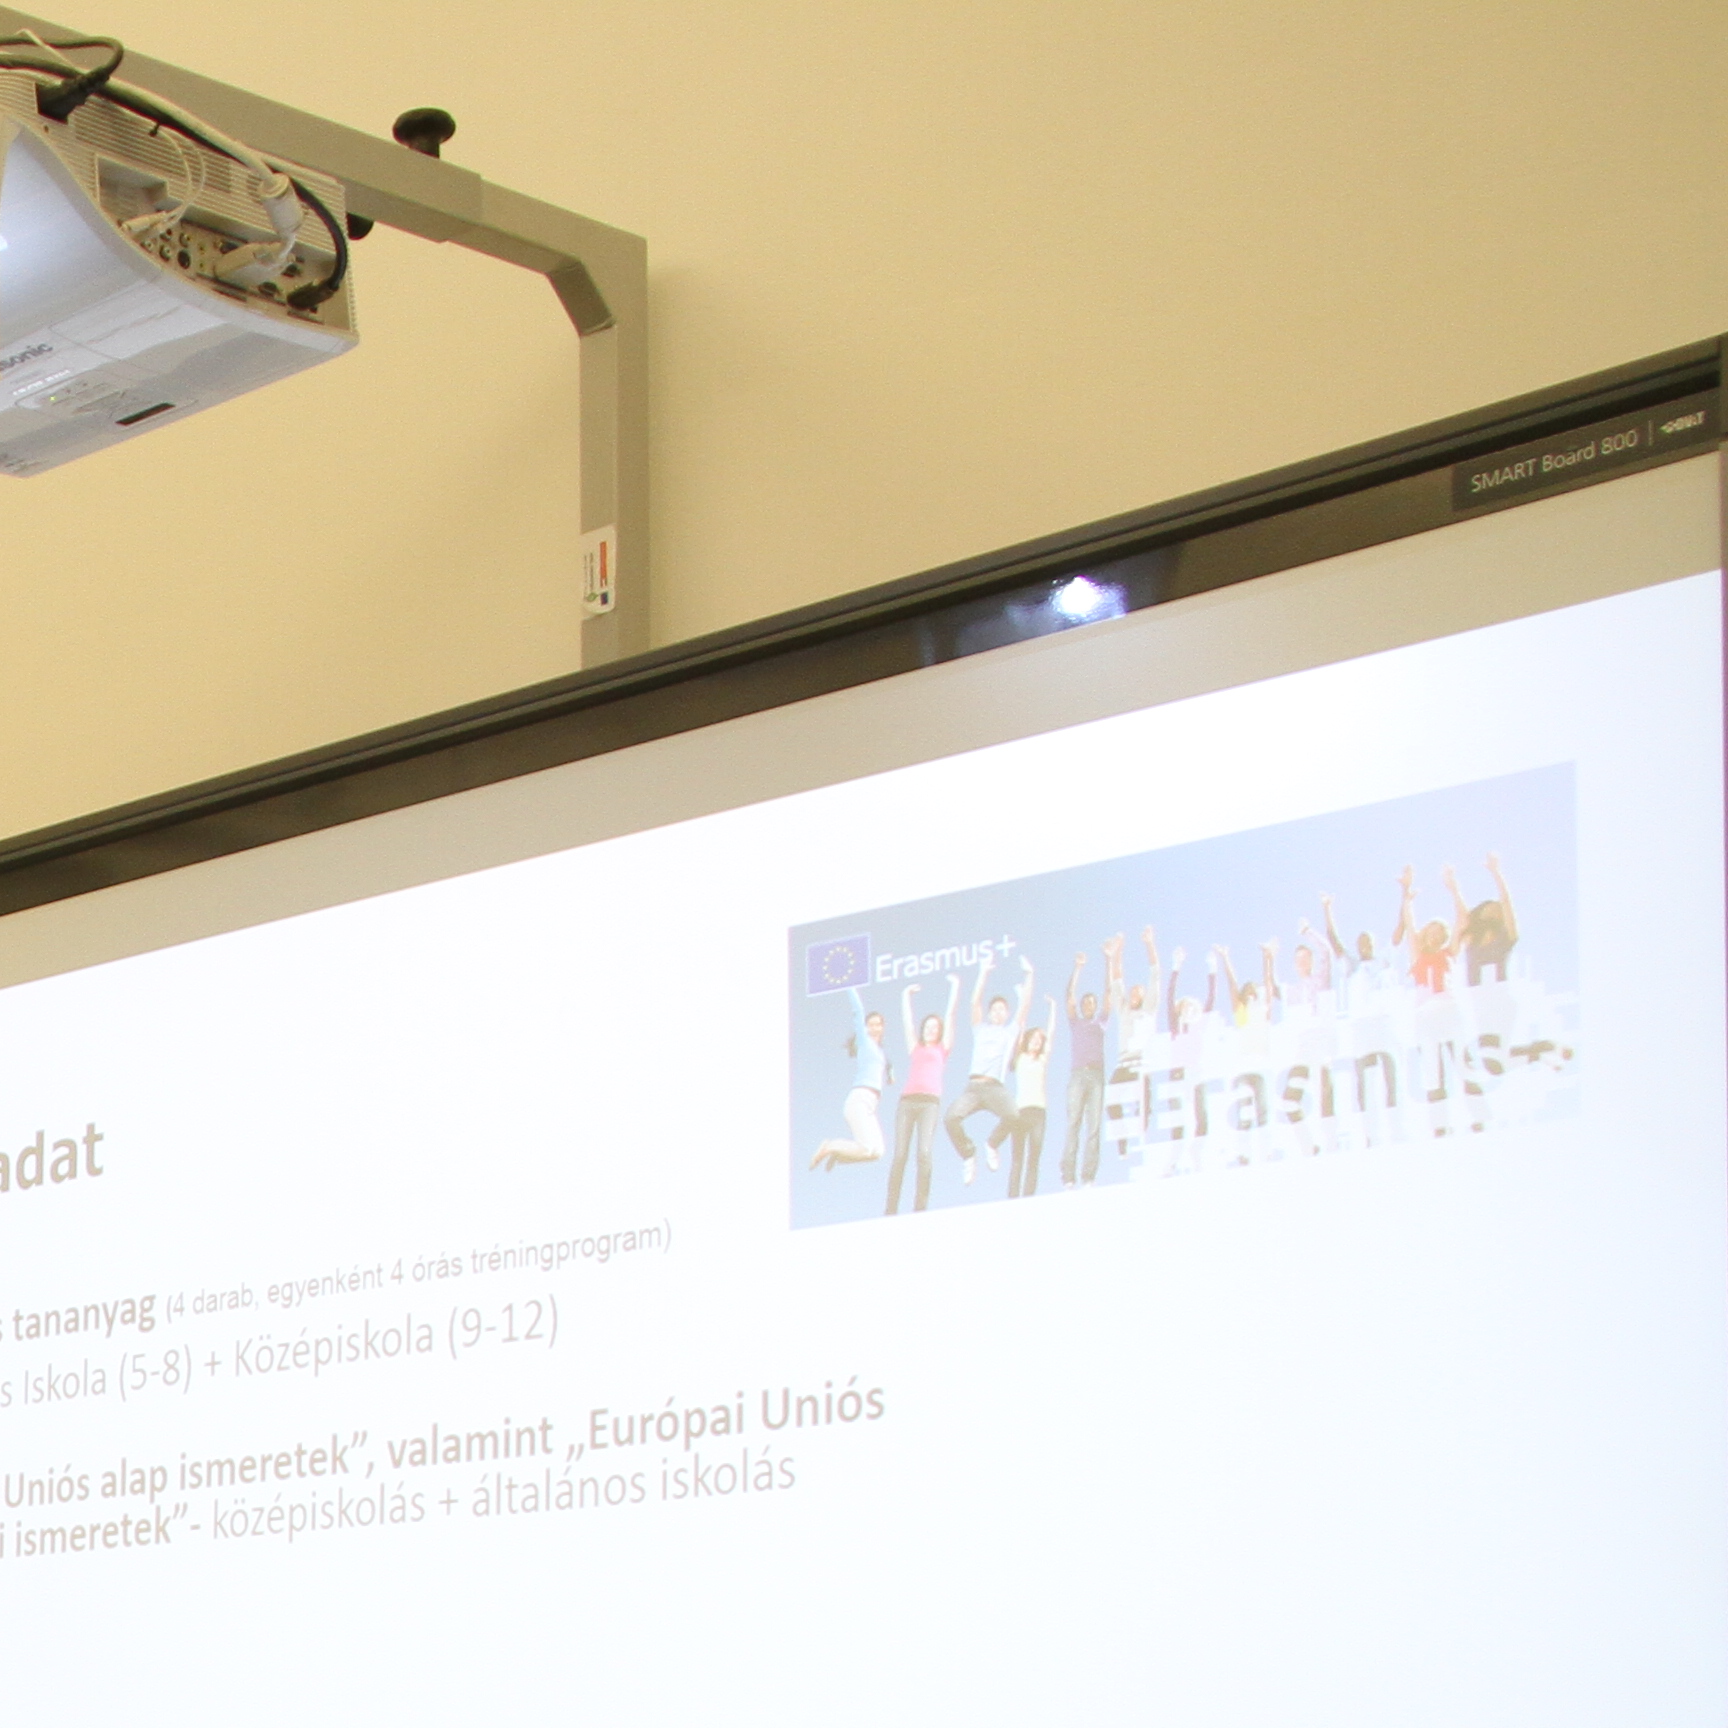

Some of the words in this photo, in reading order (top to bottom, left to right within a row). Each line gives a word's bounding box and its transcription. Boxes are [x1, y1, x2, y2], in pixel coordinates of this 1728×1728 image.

[1470, 459, 1536, 494] SMART
[1542, 441, 1596, 473] Board
[1601, 430, 1639, 455] 800
[876, 934, 1017, 982] Erasmus+
[12, 1294, 157, 1342] tananyag
[165, 1291, 185, 1324] (4
[192, 1282, 259, 1316] darab,
[266, 1262, 384, 1309] egyenként
[390, 1258, 405, 1286] 4
[411, 1251, 463, 1283] órás
[471, 1217, 672, 1274] tréningprogram)
[24, 1357, 107, 1406] Iskola
[119, 1343, 193, 1403] (5-8)
[234, 1313, 433, 1378] Középiskola
[447, 1293, 558, 1361] (9-12)
[4, 1463, 90, 1510] Uniós
[100, 1457, 168, 1504] alap
[387, 1416, 554, 1470] valamint
[565, 1391, 745, 1463] „Európai
[760, 1375, 886, 1432] Uniós
[212, 1474, 426, 1544] középiskolás
[472, 1464, 646, 1518] általános
[661, 1444, 797, 1501] iskolás
